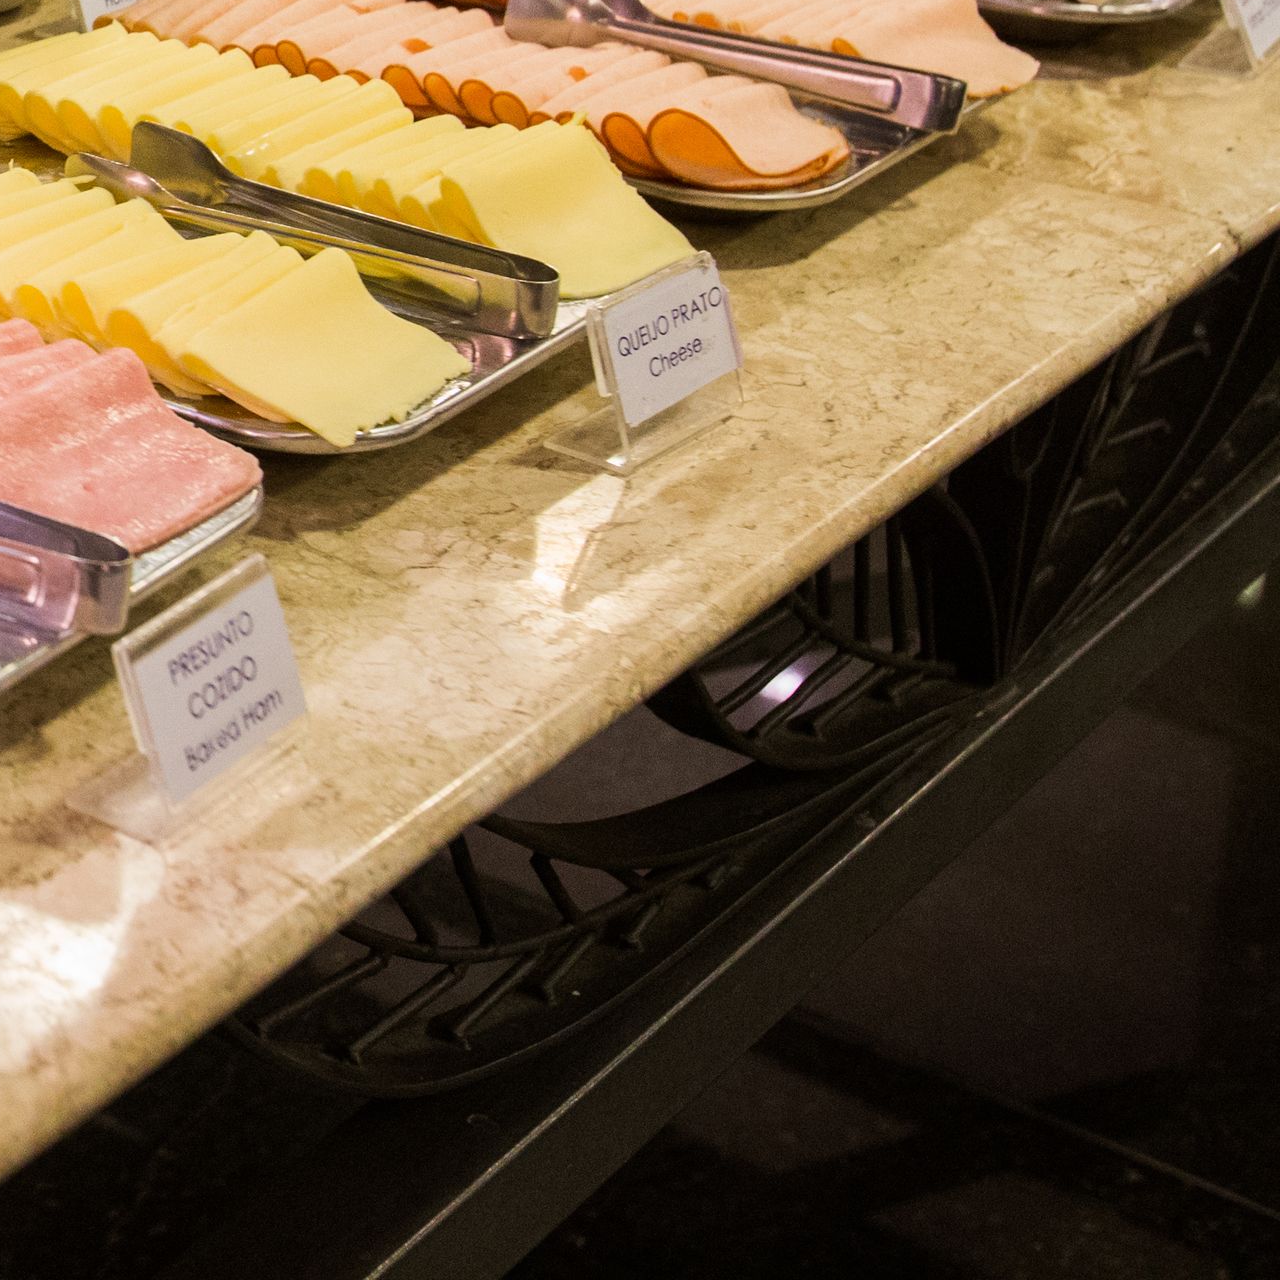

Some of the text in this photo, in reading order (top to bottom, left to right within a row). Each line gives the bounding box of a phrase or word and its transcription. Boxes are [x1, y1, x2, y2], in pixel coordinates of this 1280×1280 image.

[617, 286, 722, 357] QUEIJO PRATO
[648, 337, 703, 377] Cheese
[167, 610, 255, 687] PRESUNTO
[188, 655, 258, 719] COZIDO
[242, 689, 285, 730] Ham
